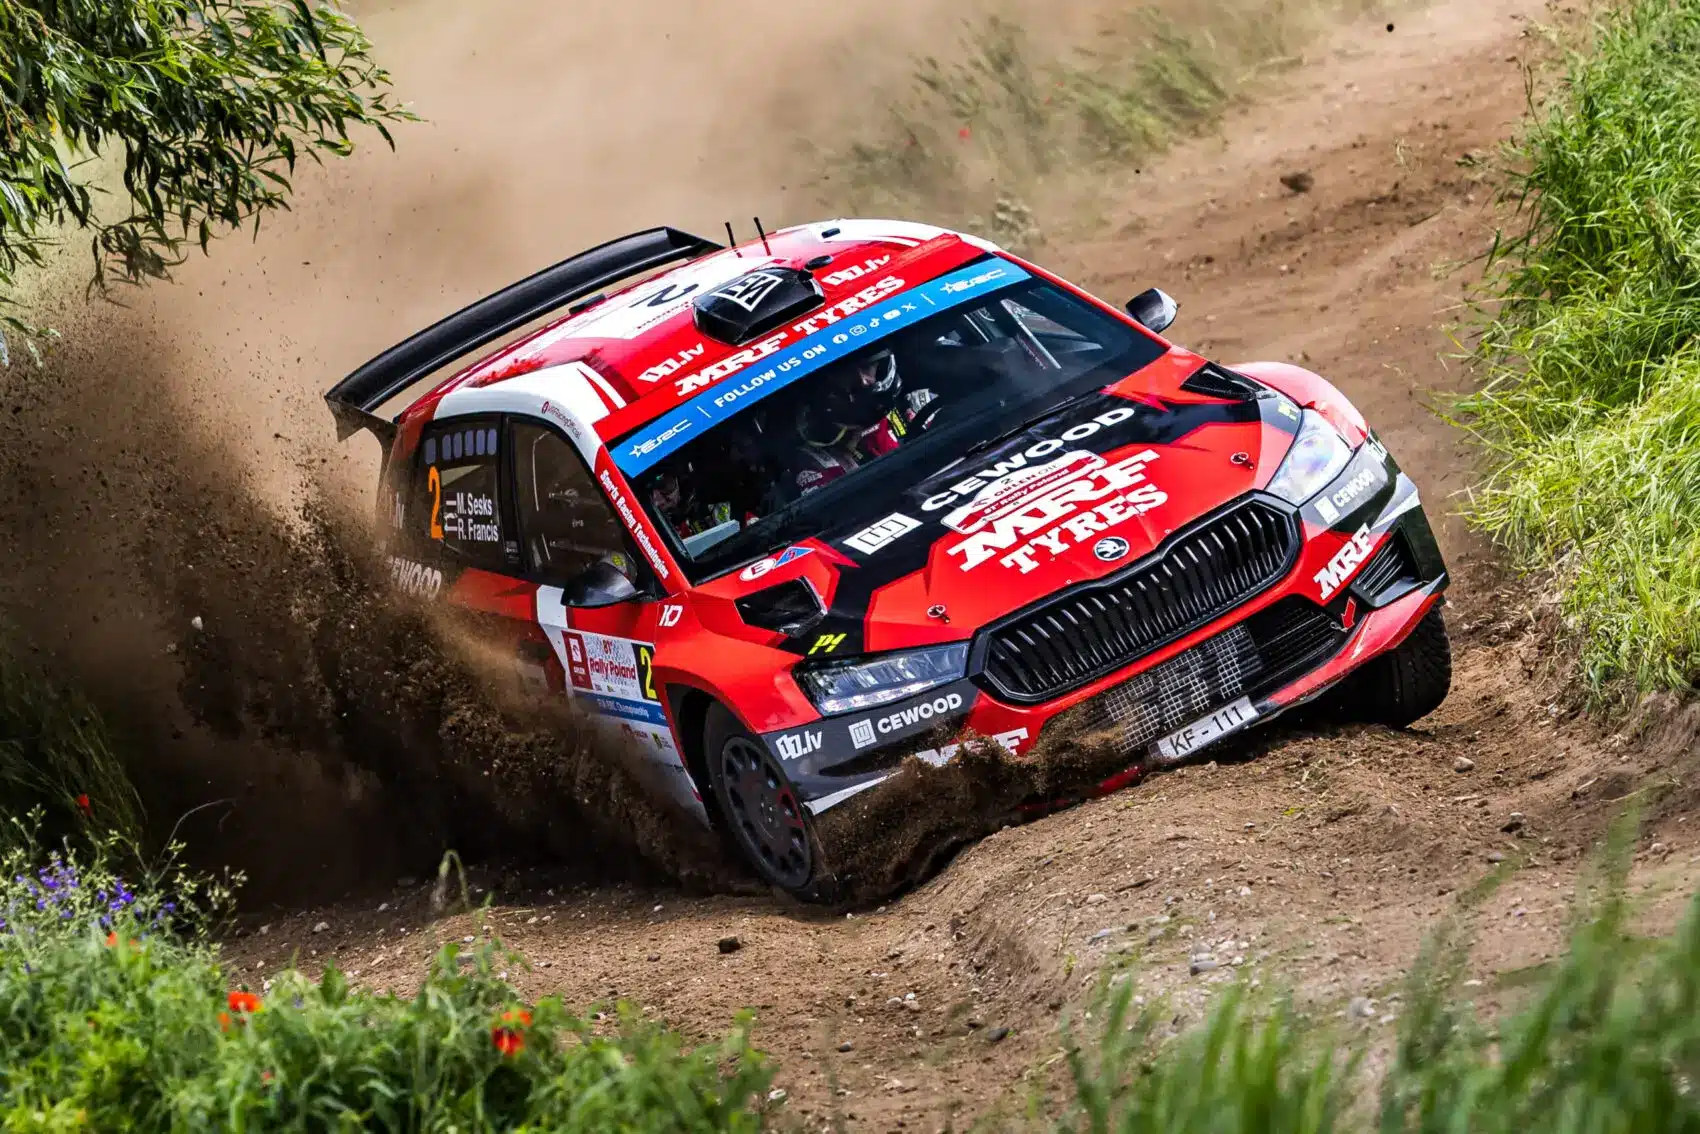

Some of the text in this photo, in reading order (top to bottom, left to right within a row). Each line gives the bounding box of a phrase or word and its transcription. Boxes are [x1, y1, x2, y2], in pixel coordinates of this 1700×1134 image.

[629, 283, 699, 308] 2
[674, 275, 905, 396] MRF TYRES
[714, 344, 827, 408] FOLLOW US ON
[921, 406, 1135, 512] CEWOOD
[994, 473, 1036, 497] ORLEN
[428, 466, 443, 540] 2
[456, 492, 493, 516] M. Sesks
[947, 450, 1160, 572] MRF
[1000, 488, 1028, 506] Rally
[1028, 468, 1070, 492] Poland
[1332, 468, 1376, 507] CEWOOD
[458, 518, 499, 542] R. Francis
[600, 469, 620, 500] Sports
[617, 496, 637, 529] Racing
[634, 522, 669, 579] Technologies
[1000, 483, 1169, 574] TYRES
[1313, 522, 1374, 601] MRF
[589, 657, 609, 679] Rally
[610, 660, 637, 680] Poland
[640, 646, 658, 699] 2
[877, 693, 963, 734] CEWOOD
